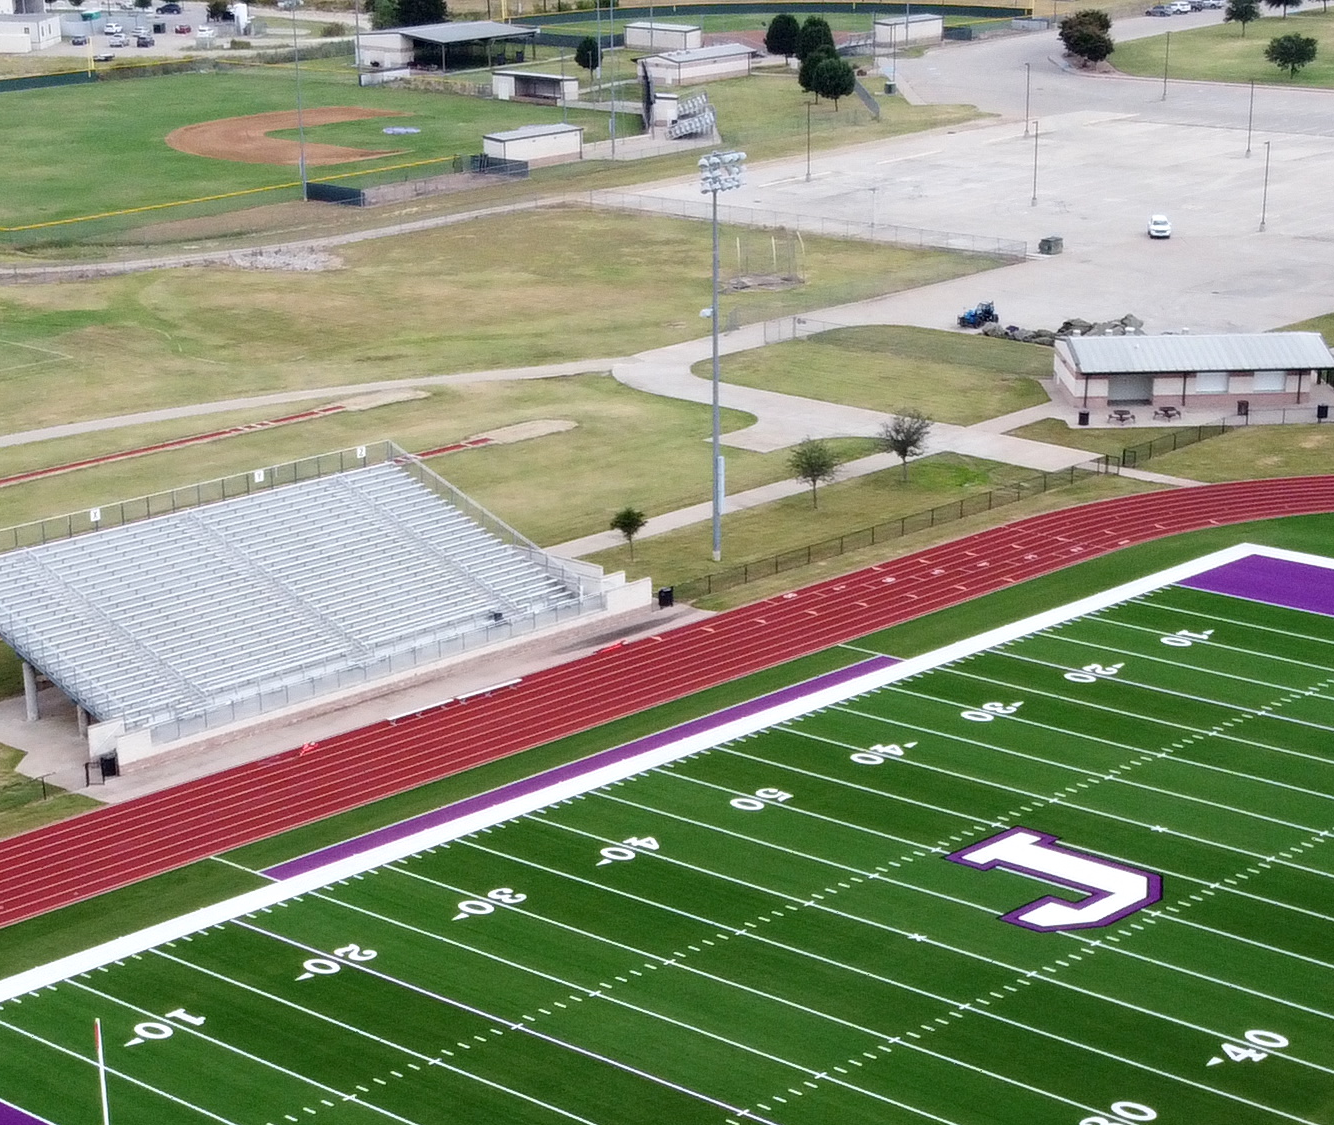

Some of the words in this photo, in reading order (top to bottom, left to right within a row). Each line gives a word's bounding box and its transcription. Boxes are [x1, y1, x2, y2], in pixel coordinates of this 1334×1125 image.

[1160, 629, 1209, 647] 10
[1064, 663, 1118, 683] 20
[961, 702, 1017, 722] 30
[850, 743, 904, 765] 40
[729, 787, 794, 811] 50
[600, 836, 660, 861] 40
[947, 828, 1159, 931] J
[458, 887, 527, 915] 30
[303, 943, 377, 974] 20
[134, 1008, 206, 1039] 10
[1221, 1030, 1289, 1062] 40
